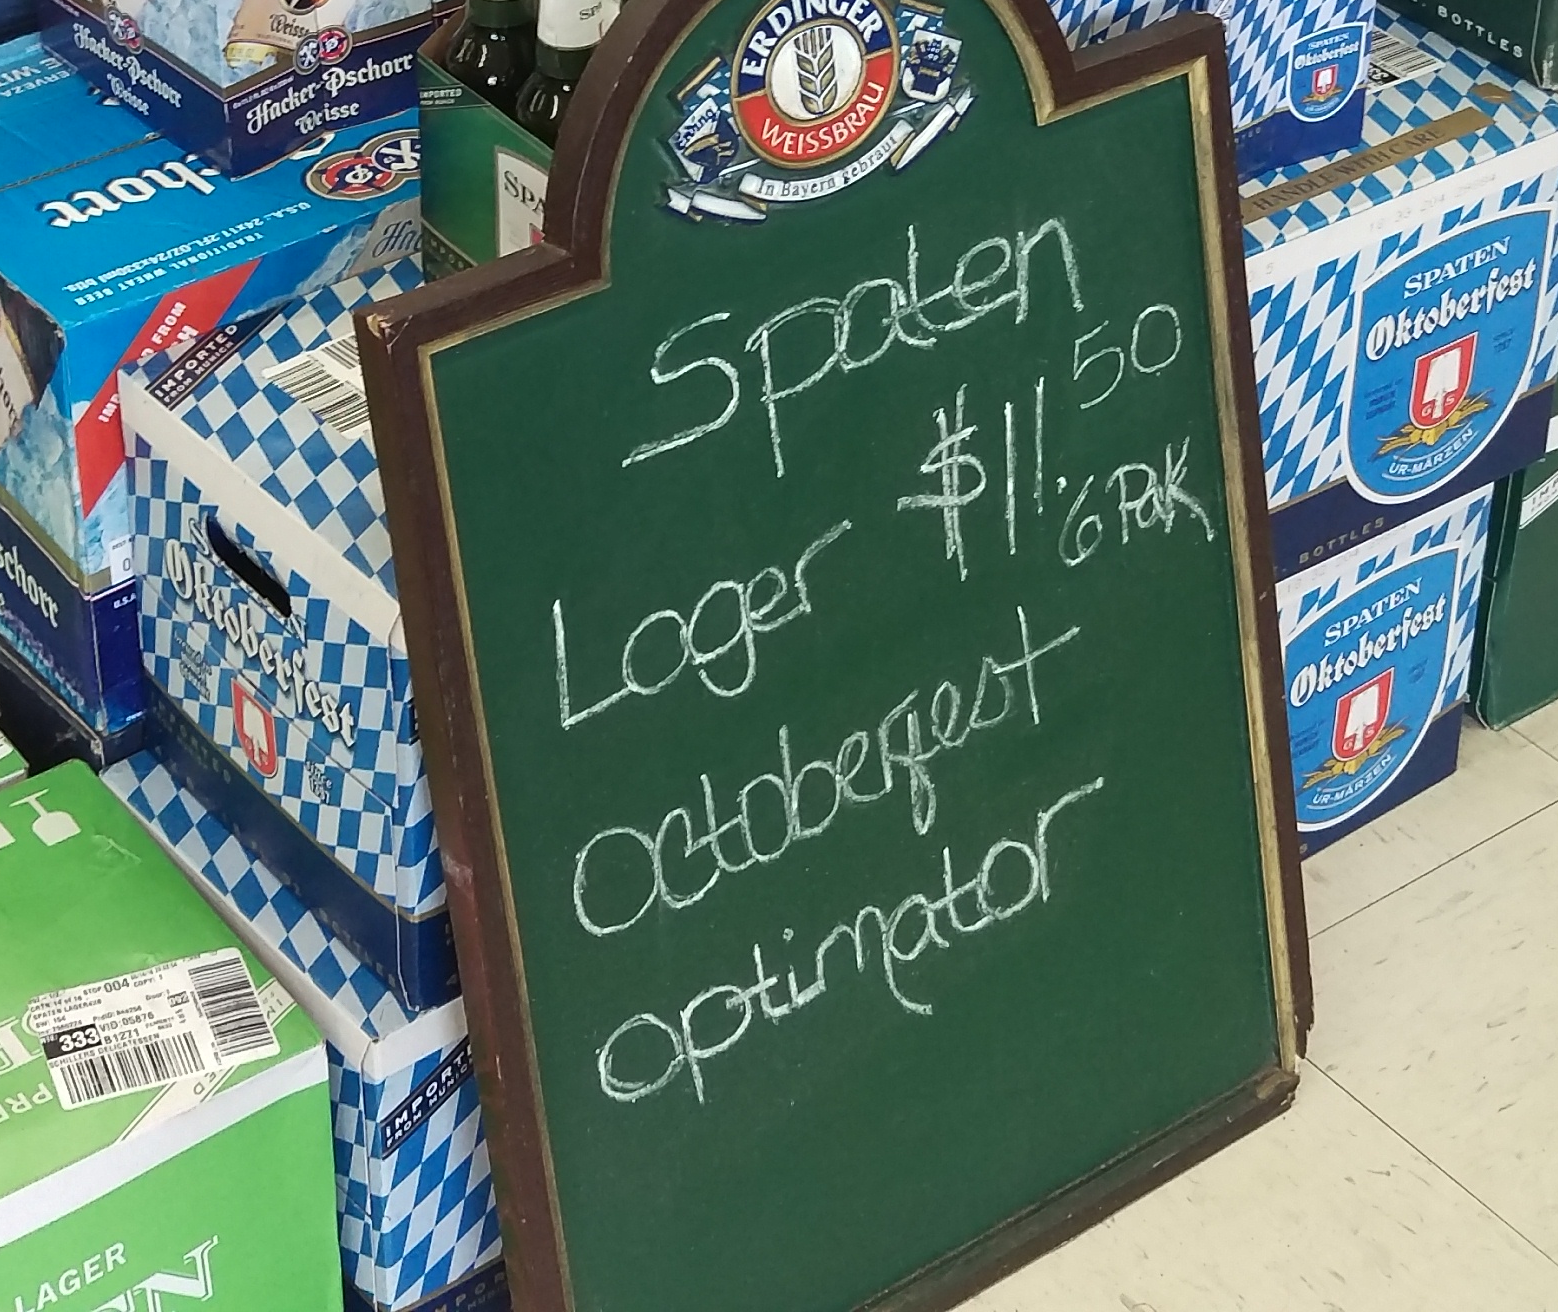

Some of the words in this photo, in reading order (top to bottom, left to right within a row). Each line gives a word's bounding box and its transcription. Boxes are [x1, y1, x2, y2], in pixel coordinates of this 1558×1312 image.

[1294, 41, 1359, 71] Oktoberfest
[1307, 31, 1351, 50] SPATEN
[1437, 5, 1524, 61] BOTTLES
[246, 51, 414, 135] Hacker-Pschorr
[294, 100, 360, 136] Weisse
[781, 176, 835, 198] Bayern
[1253, 169, 1333, 211] HANDLE
[1336, 151, 1391, 177] WITH
[1403, 236, 1510, 299] SPATEN
[1365, 259, 1536, 361] Oktoberfest
[154, 324, 239, 400] IMPORTED
[195, 341, 234, 376] MUNICH
[621, 218, 1086, 478] Spaten
[1298, 517, 1385, 564] BOTTLES
[1324, 577, 1423, 647] SPATEN
[163, 540, 356, 750] Oktoberfest
[1289, 592, 1446, 708] Oktoberfest
[103, 978, 130, 994] 004
[59, 1028, 100, 1052] 333
[104, 1028, 140, 1044] B1271
